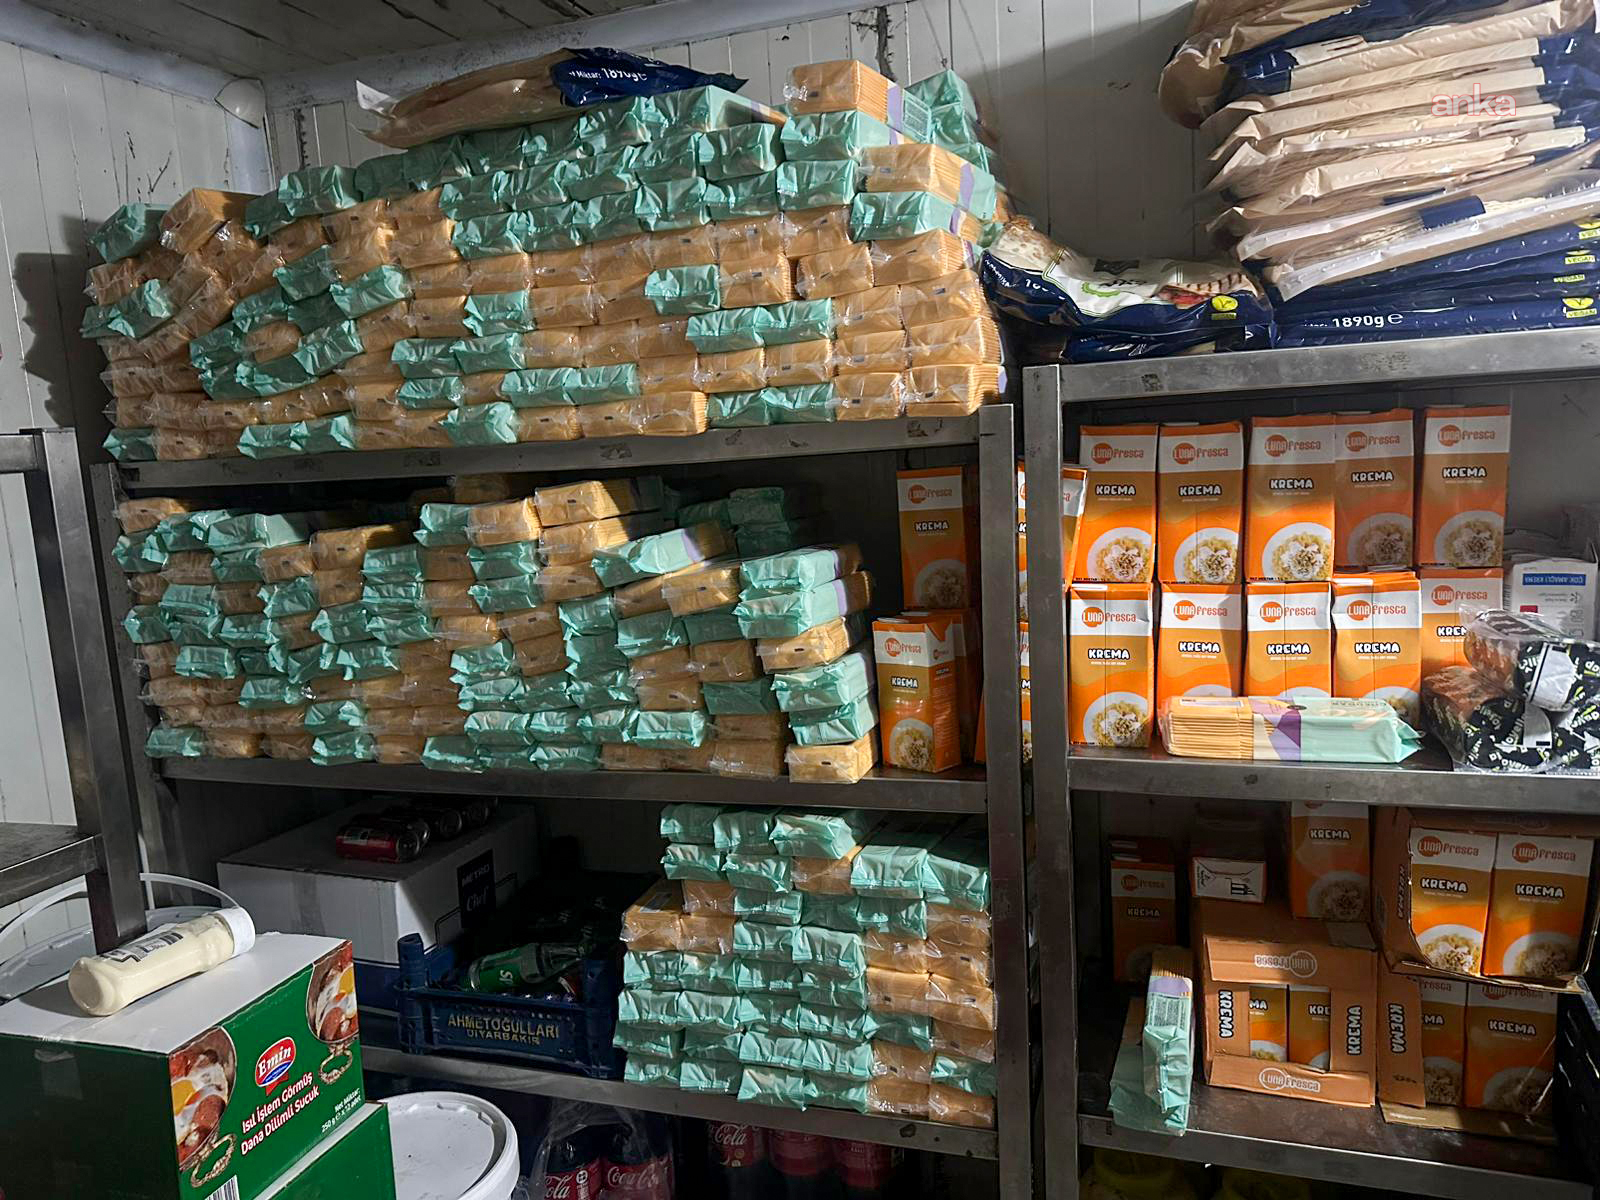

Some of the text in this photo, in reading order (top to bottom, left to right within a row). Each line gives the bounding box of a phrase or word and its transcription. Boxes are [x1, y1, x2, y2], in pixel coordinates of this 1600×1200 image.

[1352, 470, 1395, 483] KREMA
[1442, 466, 1487, 478] KREMA
[1096, 484, 1136, 496] KREMA
[1179, 484, 1222, 496] KREMA
[1270, 478, 1314, 490] KREMA
[914, 520, 950, 532] KREMA
[1178, 641, 1221, 654] KREMA
[1266, 642, 1312, 655] KREMA
[1355, 642, 1401, 654] KREMA
[1088, 648, 1130, 661] KREMA
[890, 676, 919, 689] KREMA
[1310, 828, 1352, 841] KREMA
[1421, 877, 1468, 894] KREMA
[1516, 884, 1565, 898] KREMA
[1219, 990, 1234, 1039] KREMA
[1347, 1005, 1362, 1056] KREMA
[1389, 1003, 1406, 1054] KREMA
[1488, 1020, 1536, 1036] KREMA
[258, 1045, 292, 1078] Emin
[240, 1086, 320, 1156] Dana Dilimli Sucuk
[322, 1120, 332, 1132] 250
